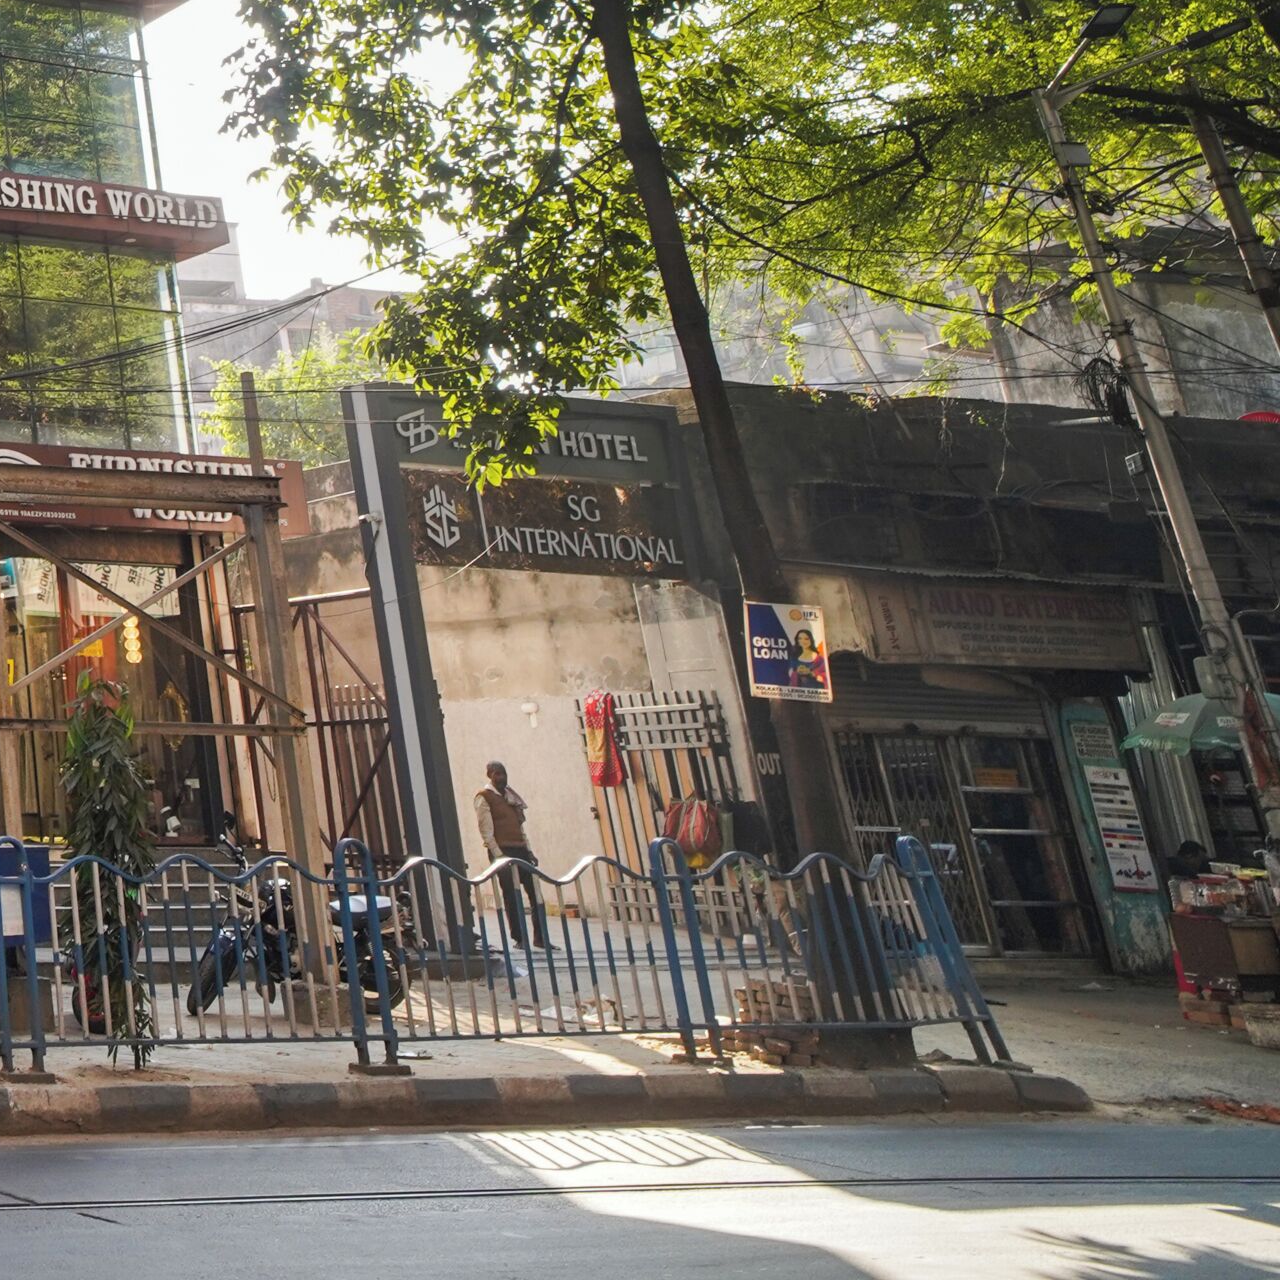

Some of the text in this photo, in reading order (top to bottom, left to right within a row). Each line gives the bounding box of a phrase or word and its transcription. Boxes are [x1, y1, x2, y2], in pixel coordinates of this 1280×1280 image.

[104, 188, 218, 229] WORLD
[558, 430, 649, 463] HOTEL
[567, 494, 601, 523] SG
[493, 525, 684, 565] INTERNATIONAL
[752, 636, 788, 648] GOLD
[753, 648, 789, 660] LOAN
[757, 752, 782, 775] OUT
